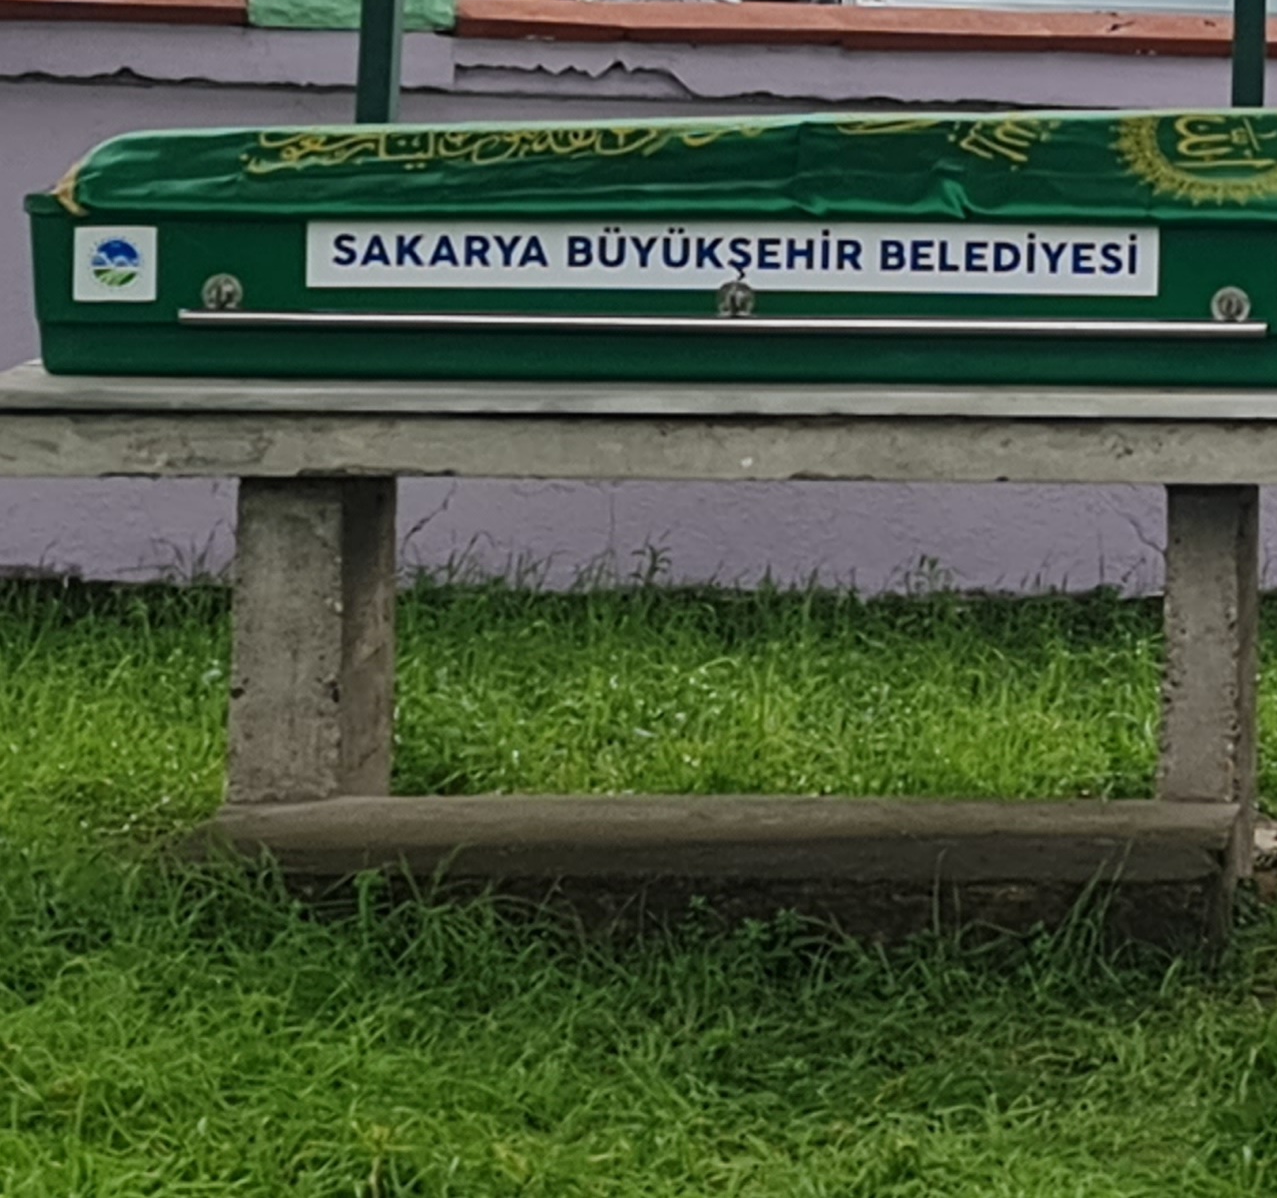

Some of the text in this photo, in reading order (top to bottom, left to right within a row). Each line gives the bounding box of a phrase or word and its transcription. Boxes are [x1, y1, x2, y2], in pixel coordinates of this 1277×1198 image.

[332, 227, 1138, 281] SAKARYA BÜYÜKŞEHİR BELEDİYESİ
